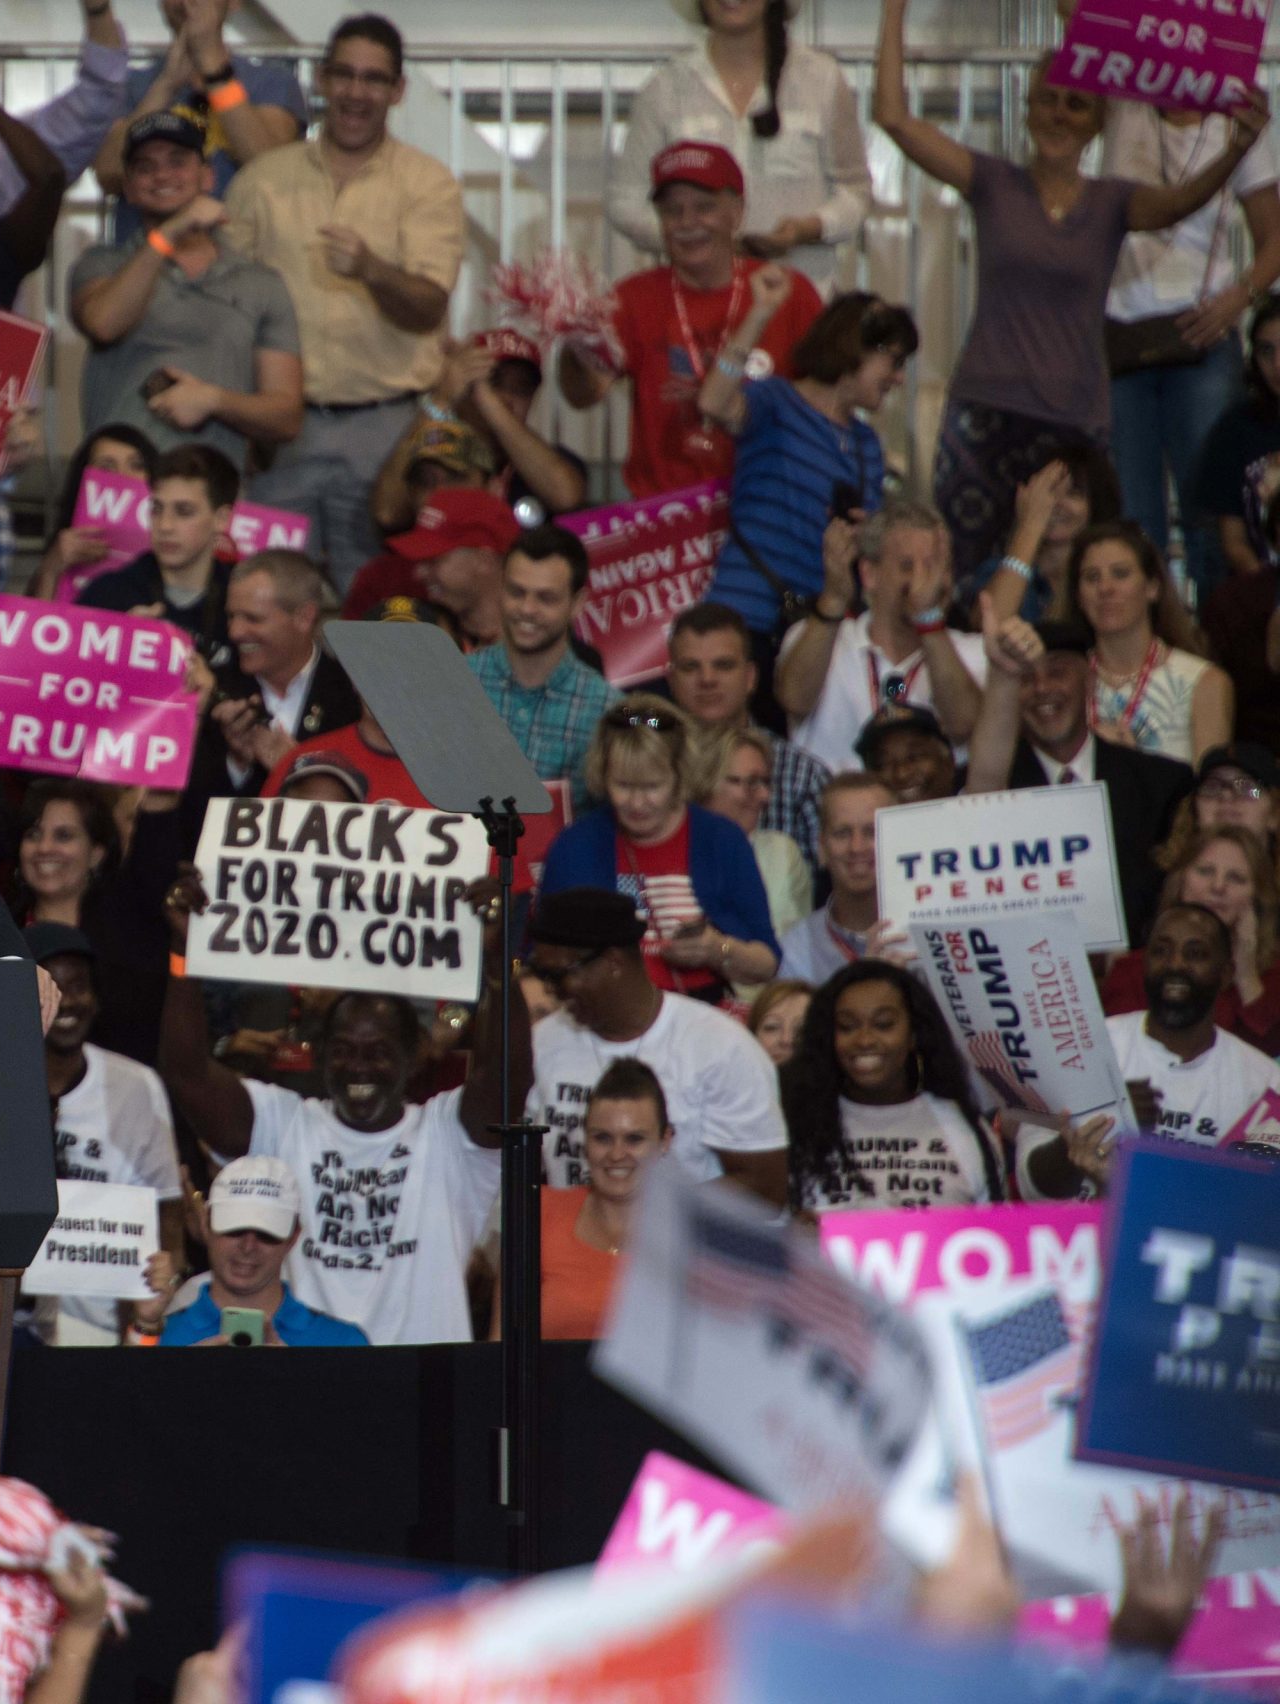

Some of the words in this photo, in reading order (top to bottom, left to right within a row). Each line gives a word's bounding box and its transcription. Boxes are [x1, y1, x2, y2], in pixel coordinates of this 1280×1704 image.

[1135, 14, 1208, 54] FOR
[38, 671, 122, 711] FOR
[897, 833, 1091, 880] TRUMP
[216, 856, 300, 907] FOR
[312, 862, 468, 922] TRUMP
[915, 868, 1076, 903] PENCE
[207, 899, 462, 969] 2020.COM
[945, 930, 974, 976] FOR
[924, 929, 977, 1038] VETERANS
[968, 927, 1039, 1084] TRUMP
[1028, 938, 1086, 1071] AMERICA
[929, 1138, 948, 1154] &
[1196, 1117, 1219, 1137] &
[887, 1173, 944, 1195] Not
[98, 1217, 119, 1234] for
[122, 1221, 144, 1236] our
[320, 1218, 395, 1248] Racis
[46, 1239, 141, 1267] President
[826, 1223, 1102, 1302] WOM
